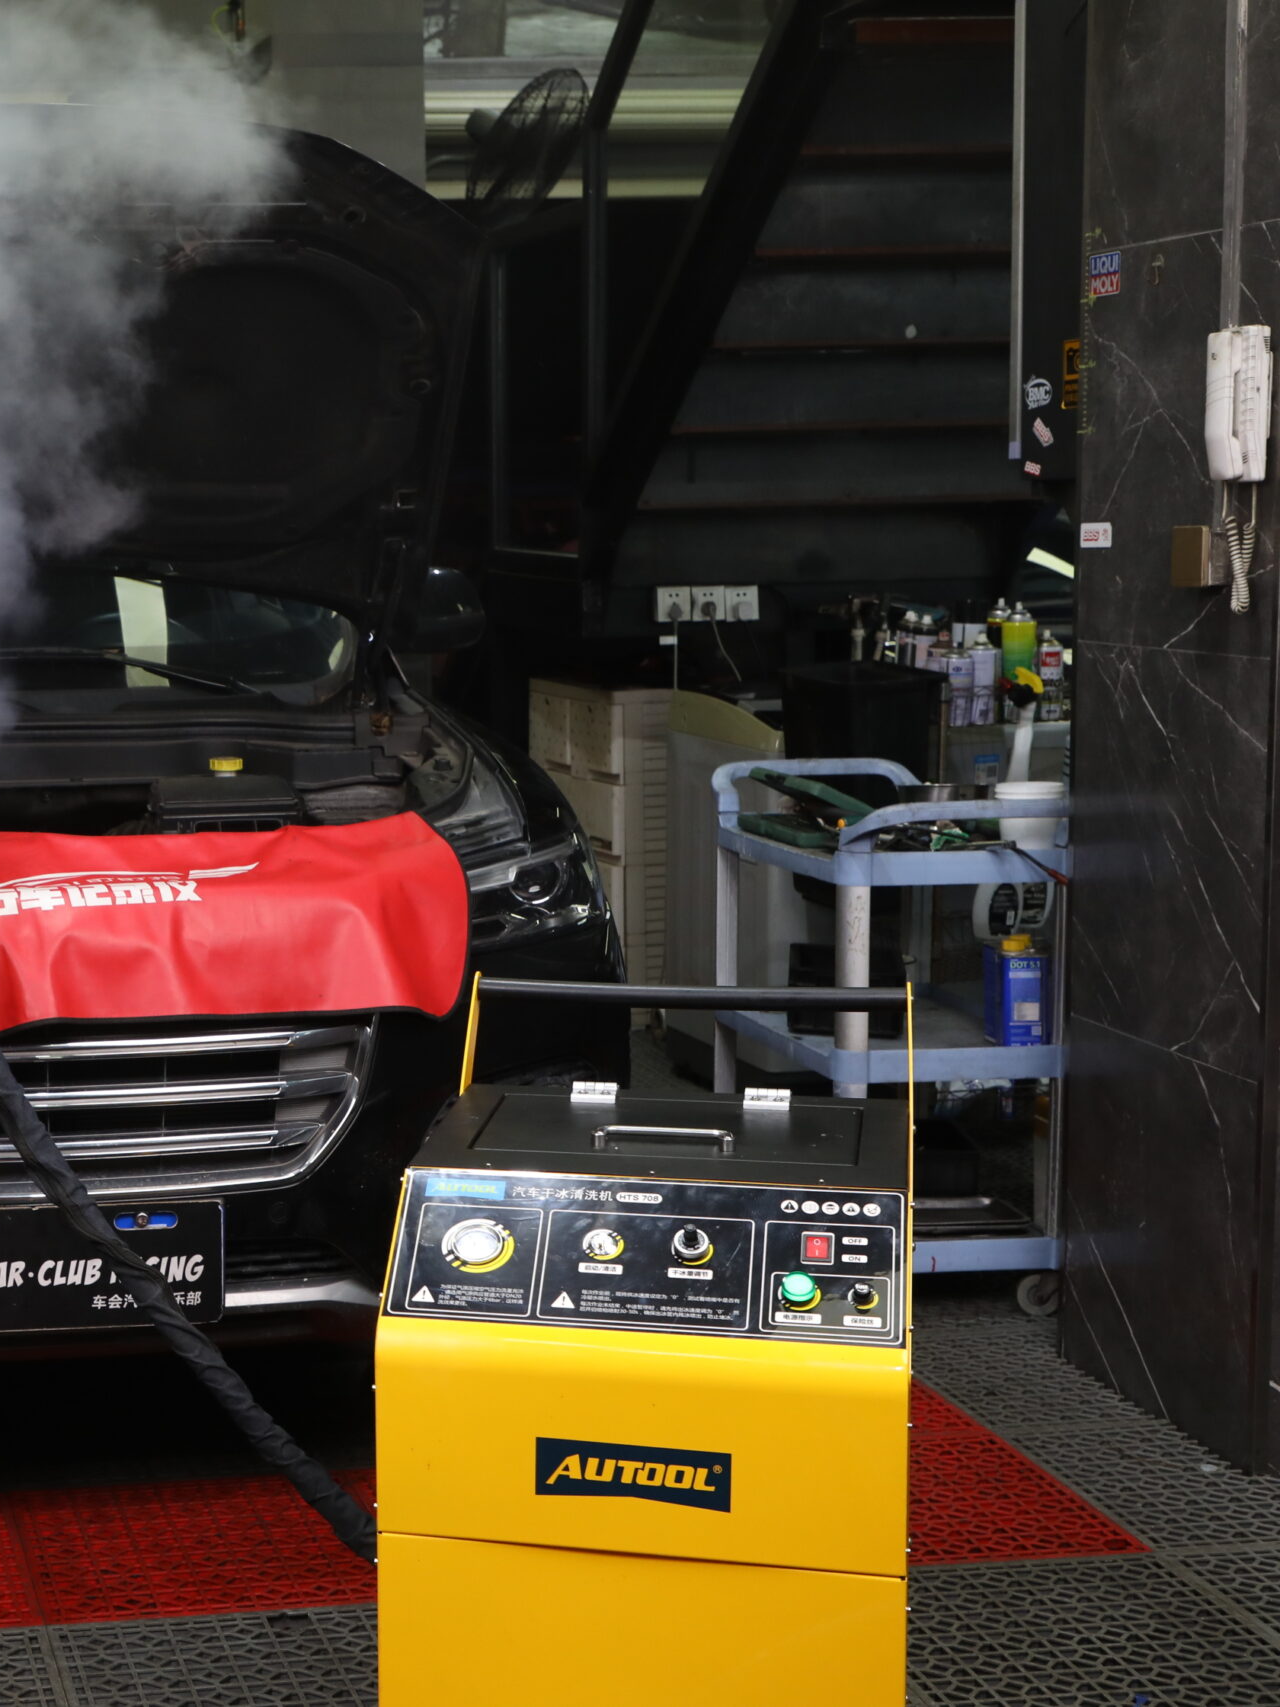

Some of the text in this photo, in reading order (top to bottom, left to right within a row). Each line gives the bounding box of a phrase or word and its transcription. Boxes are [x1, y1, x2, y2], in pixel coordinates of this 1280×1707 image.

[1091, 254, 1119, 275] LIQUI
[1090, 273, 1120, 294] MOLY
[1024, 461, 1041, 475] BBS
[1010, 961, 1028, 969] DOT
[512, 1186, 613, 1201] 汽车干冰清洗机
[642, 1194, 659, 1202] 708
[109, 1254, 204, 1285] ING
[91, 1291, 202, 1310] 车会汽乐部
